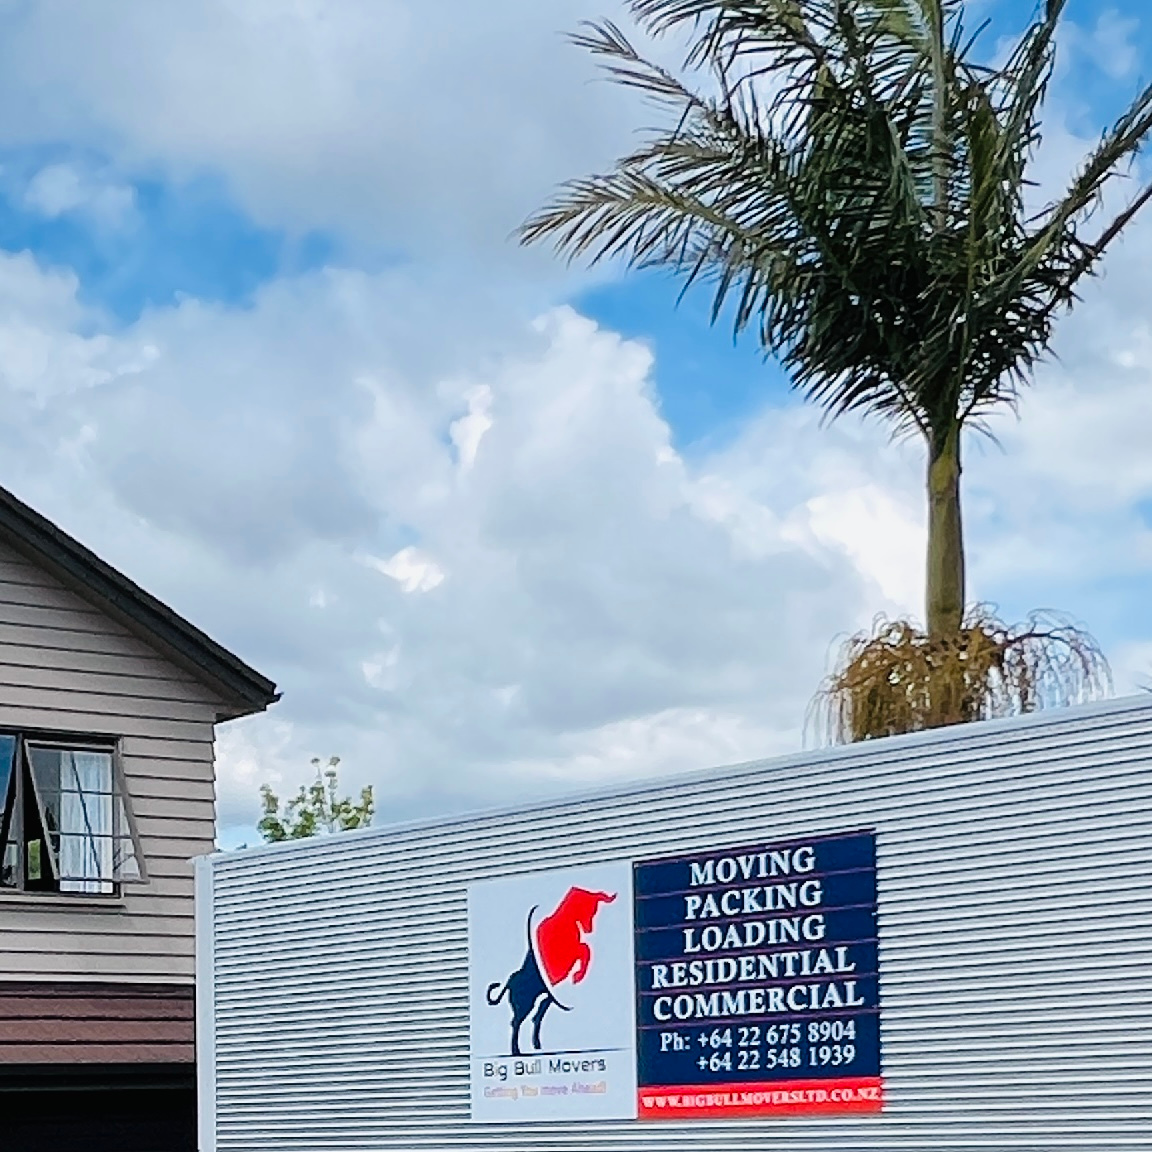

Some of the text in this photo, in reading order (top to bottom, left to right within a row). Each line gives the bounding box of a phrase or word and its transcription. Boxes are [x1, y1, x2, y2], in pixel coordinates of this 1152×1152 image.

[689, 847, 816, 887] MOVING
[684, 880, 823, 920] PACKING
[683, 914, 826, 954] LOADING
[651, 947, 857, 989] RESIDENTIAL
[653, 981, 865, 1021] COMMERCIAL
[660, 1020, 857, 1051] Ph: +64 22 675 8904
[483, 1059, 607, 1081] Big Bull Movers
[697, 1045, 856, 1072] +64 22 548 1939
[642, 1087, 880, 1108] WWW.BIGBULLMOVERSLTD.CO.NZ
